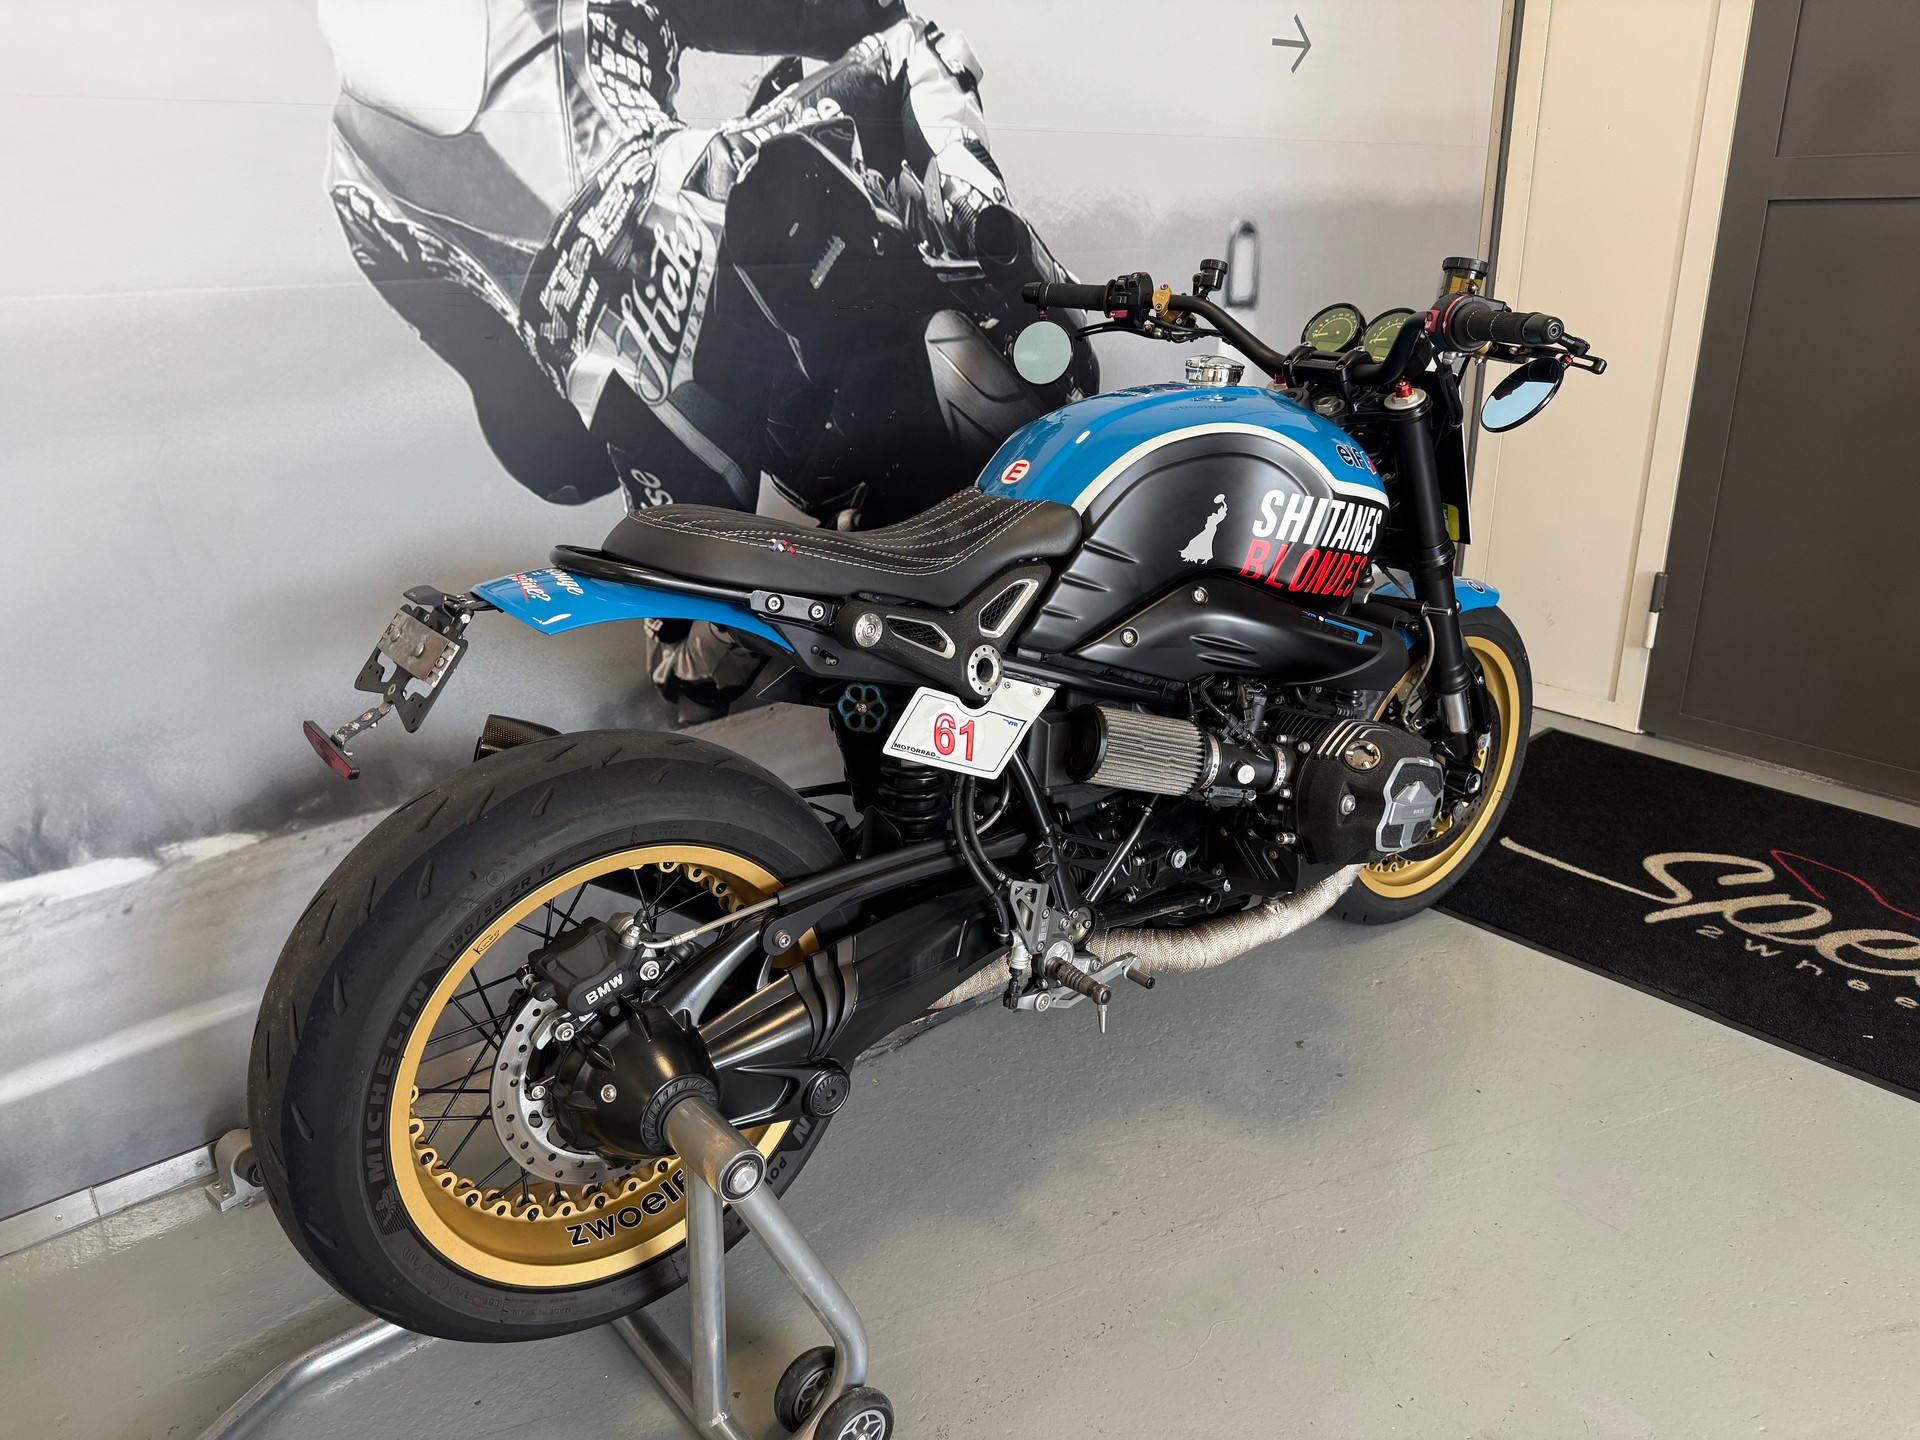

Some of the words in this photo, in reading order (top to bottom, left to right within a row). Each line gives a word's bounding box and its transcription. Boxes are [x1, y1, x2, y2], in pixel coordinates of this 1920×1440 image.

[682, 260, 711, 358] SIXTY
[1336, 444, 1364, 469] elf
[1252, 489, 1383, 554] SHITANES
[1239, 538, 1368, 598] BLONDES
[893, 742, 937, 758] MOTORRAD
[933, 712, 975, 762] 61
[447, 896, 503, 952] 190/55
[509, 876, 531, 898] ZR
[540, 861, 557, 877] 17
[585, 973, 624, 1005] BMW
[366, 979, 429, 1185] MICHELIN
